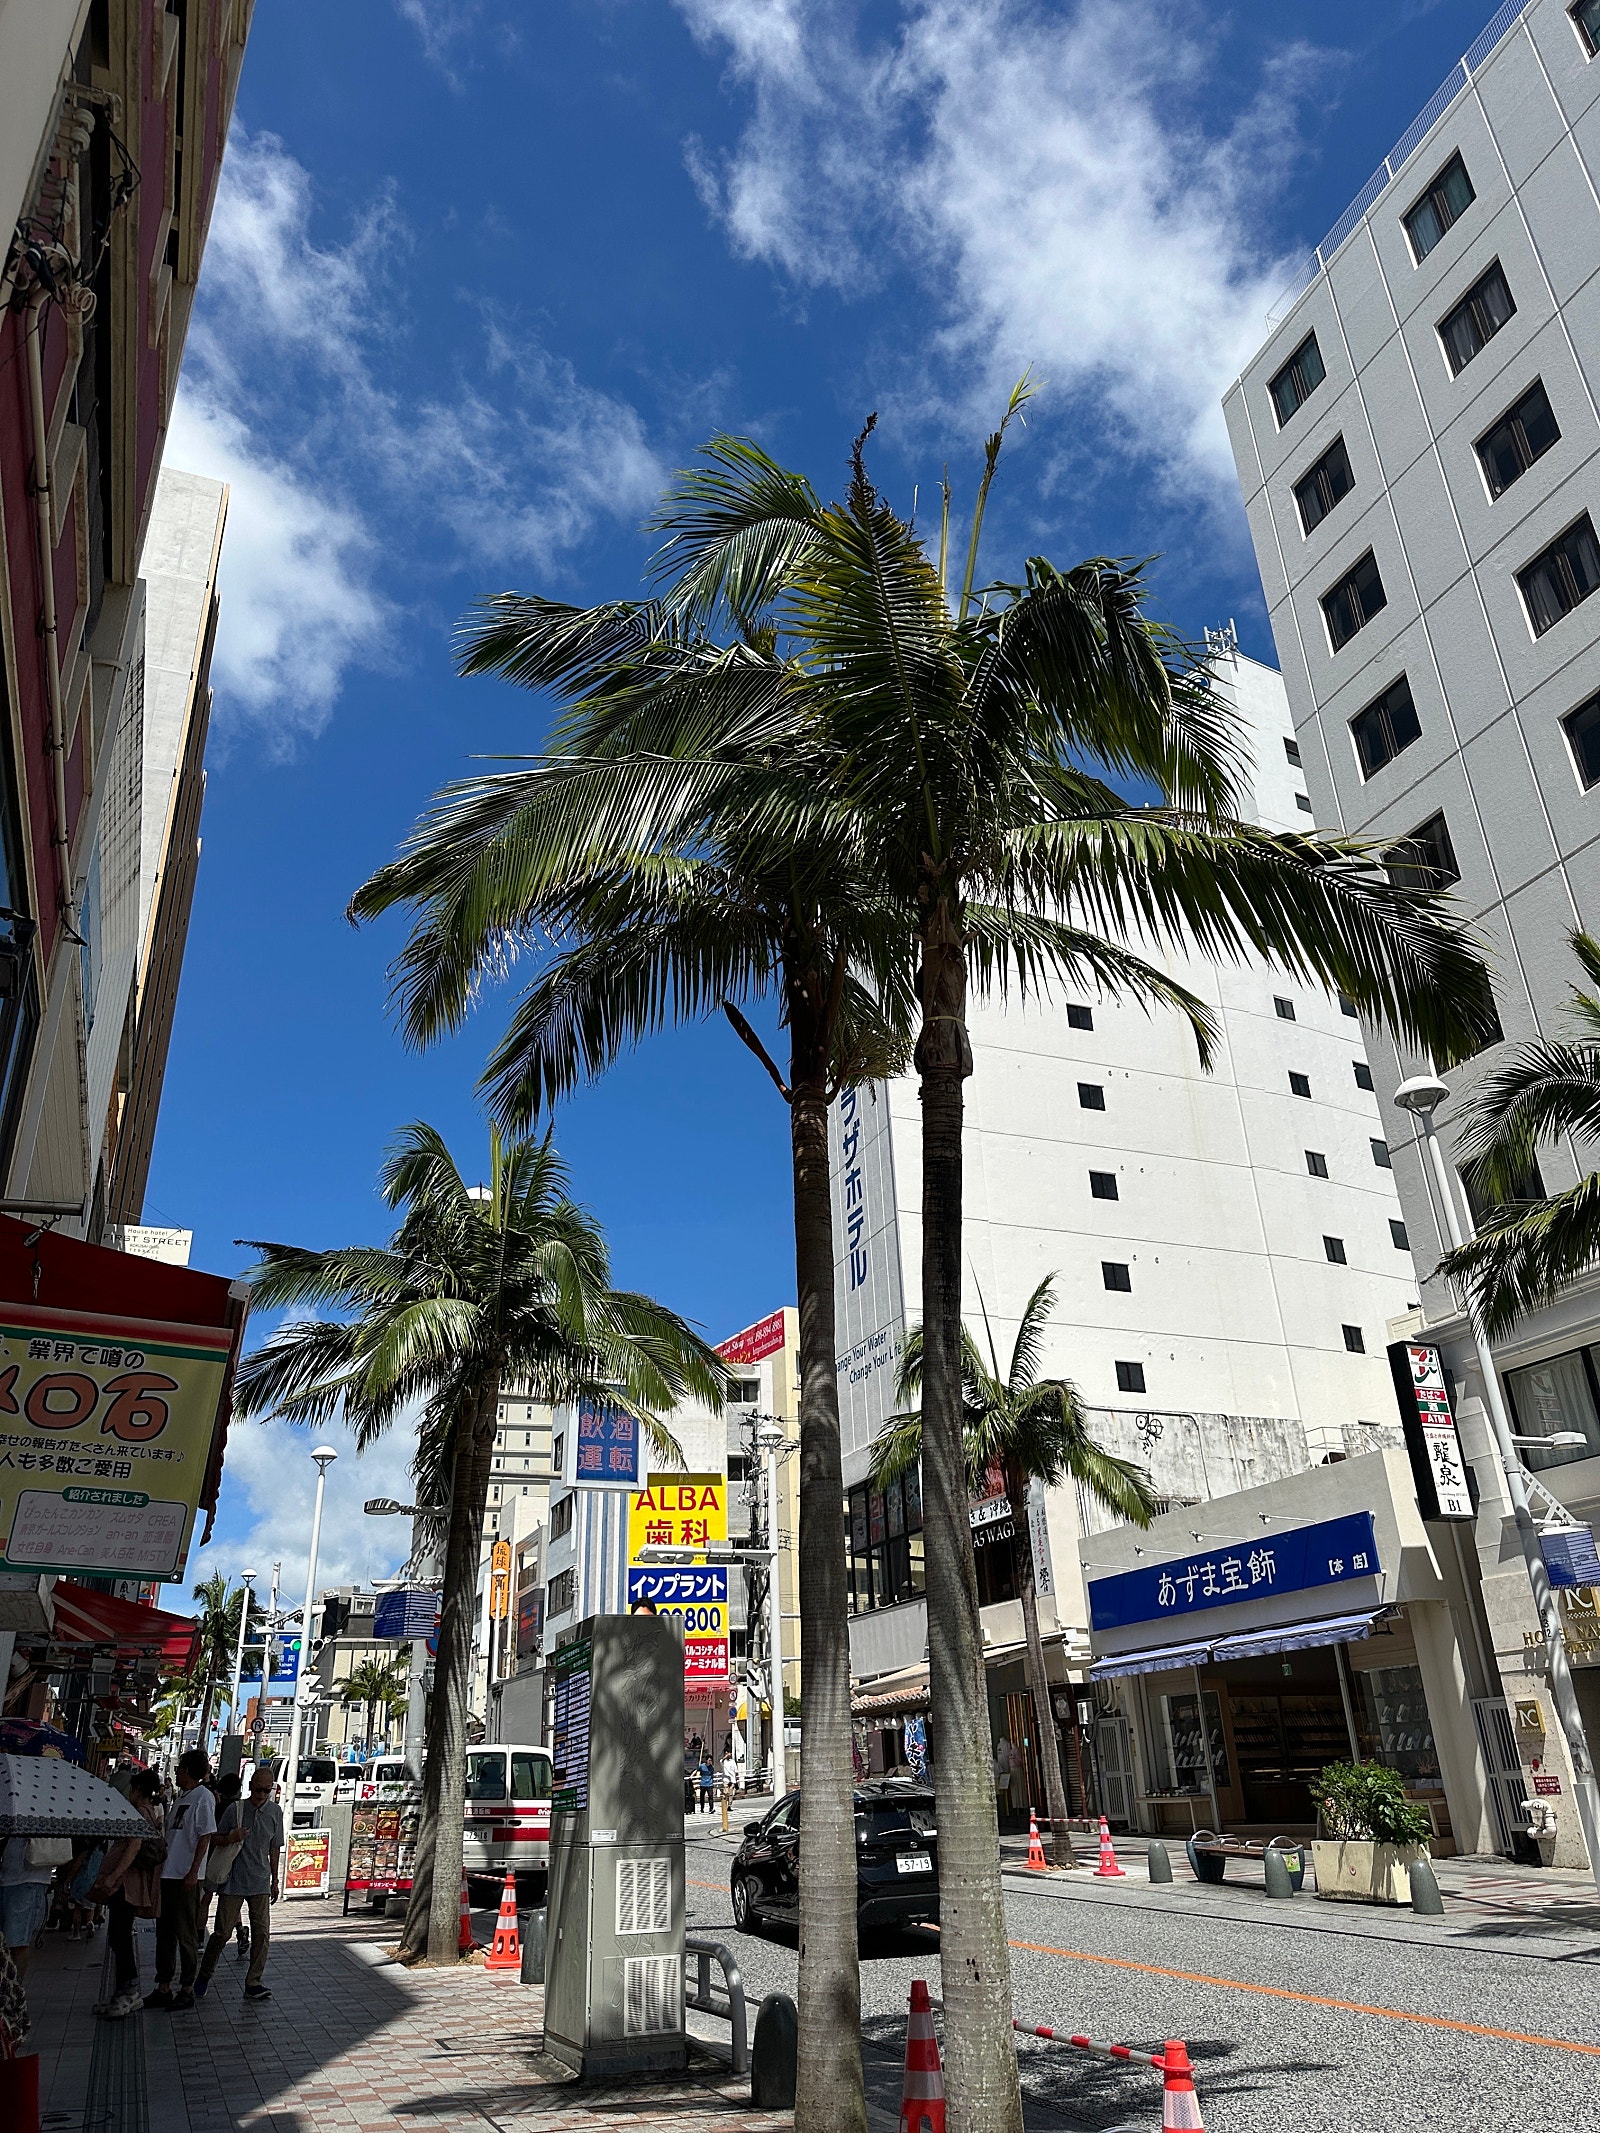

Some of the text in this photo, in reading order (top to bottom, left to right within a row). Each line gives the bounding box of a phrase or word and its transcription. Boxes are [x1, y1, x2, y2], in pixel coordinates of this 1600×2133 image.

[103, 1233, 190, 1247] FIRST STREET
[150, 1229, 168, 1237] hotel
[835, 1331, 887, 1375] ange Your Water
[849, 1362, 872, 1384] Change
[872, 1352, 888, 1370] Your
[1420, 1390, 1442, 1400] たばこ
[580, 1412, 634, 1441] 飲酒
[1427, 1415, 1446, 1424] ATM
[578, 1444, 633, 1472] 運転
[1433, 1441, 1461, 1486] 龍泉
[68, 1488, 144, 1505] 紹介されました
[635, 1486, 720, 1511] ALBA
[1447, 1499, 1462, 1511] B1
[109, 1512, 144, 1524] ズムサタ
[147, 1515, 176, 1527] CREA
[18, 1523, 102, 1537] 東京ガールズコレクション
[645, 1518, 711, 1549] 歯科
[973, 1529, 985, 1548] A5
[15, 1540, 53, 1555] 女性自身
[100, 1546, 135, 1560] 美人百花
[496, 1546, 508, 1567] 琉球
[630, 1572, 726, 1599] インプラント
[1158, 1549, 1276, 1607] あずま宝飾
[684, 1658, 727, 1670] ターミナル院
